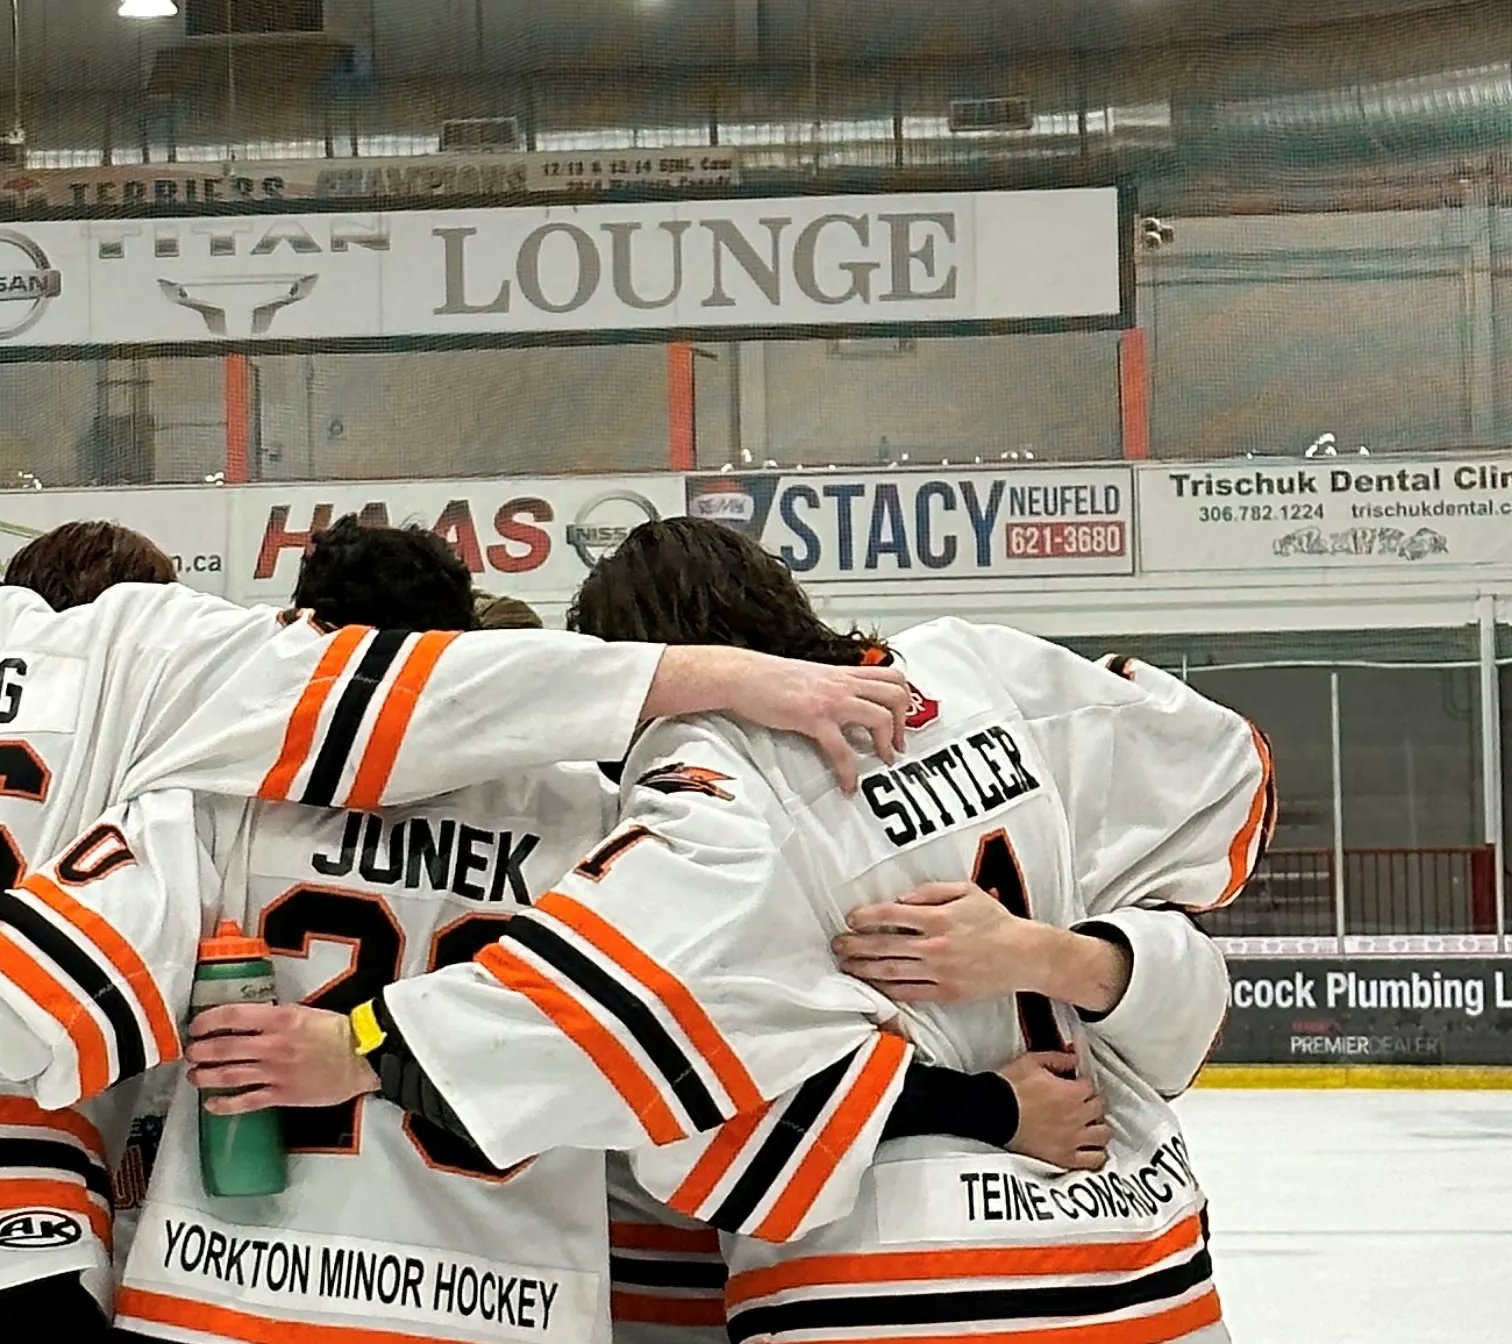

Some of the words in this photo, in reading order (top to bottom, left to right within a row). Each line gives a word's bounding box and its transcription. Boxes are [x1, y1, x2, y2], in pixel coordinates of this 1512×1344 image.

[432, 211, 959, 317] LOUNGE
[1169, 469, 1318, 498] Trischuk
[1331, 467, 1441, 493] Dental
[1198, 504, 1325, 523] 306.782.1224
[254, 496, 555, 579] HAS
[575, 527, 628, 542] NISS
[779, 479, 1006, 573] STACY
[1010, 485, 1121, 518] NEUFELD
[1010, 525, 1121, 556] 621-3680
[861, 725, 1041, 847] SITTLER
[311, 811, 542, 907] JUNEK
[1227, 971, 1318, 1009] cock
[1326, 971, 1485, 1017] Plumbing
[960, 1172, 1055, 1221] TEINE
[163, 1218, 311, 1296] YORKTON
[317, 1247, 425, 1309] MINOR
[432, 1263, 559, 1331] HOCKEY
